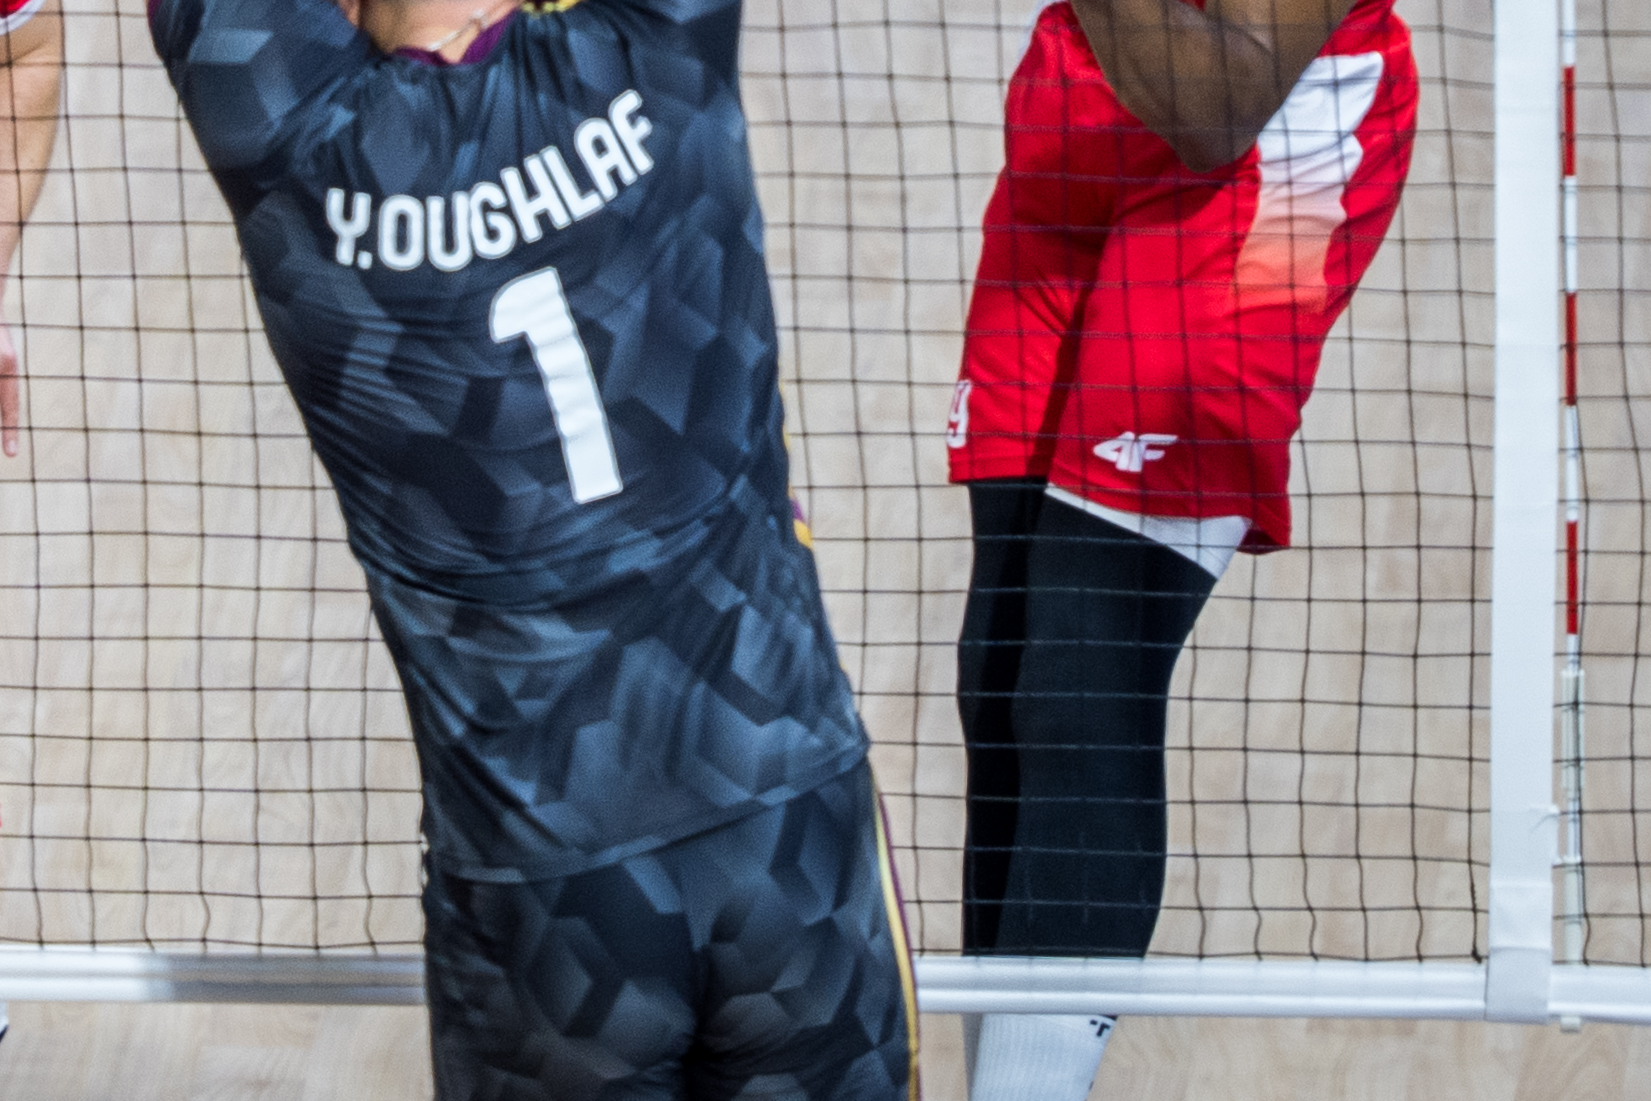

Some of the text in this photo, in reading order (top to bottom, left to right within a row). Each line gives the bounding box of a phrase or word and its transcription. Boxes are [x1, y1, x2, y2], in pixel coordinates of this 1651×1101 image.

[325, 88, 654, 272] Y.OUGHLAF
[489, 266, 624, 505] 1
[1093, 431, 1179, 473] 4F
